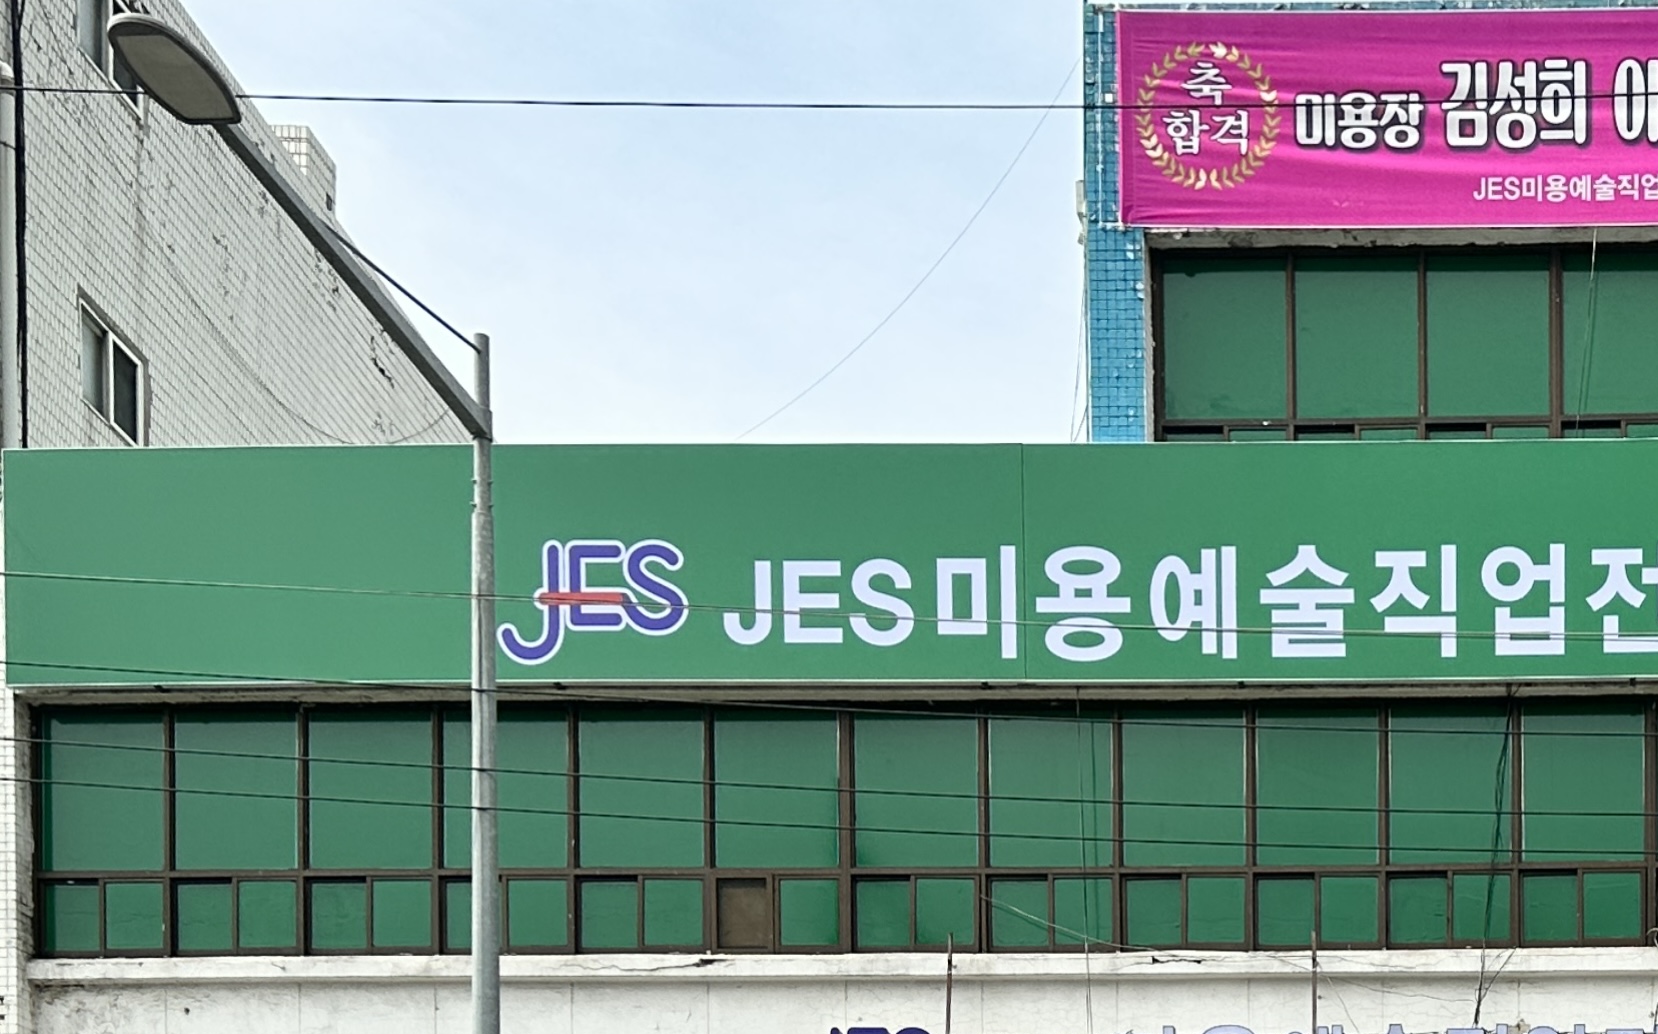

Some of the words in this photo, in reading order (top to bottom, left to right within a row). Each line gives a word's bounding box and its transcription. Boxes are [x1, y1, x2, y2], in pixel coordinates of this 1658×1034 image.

[1182, 63, 1232, 105] 축
[1294, 91, 1423, 150] 미용장
[1439, 61, 1587, 150] 김성희
[1161, 110, 1252, 156] 합격
[499, 540, 689, 665] JES
